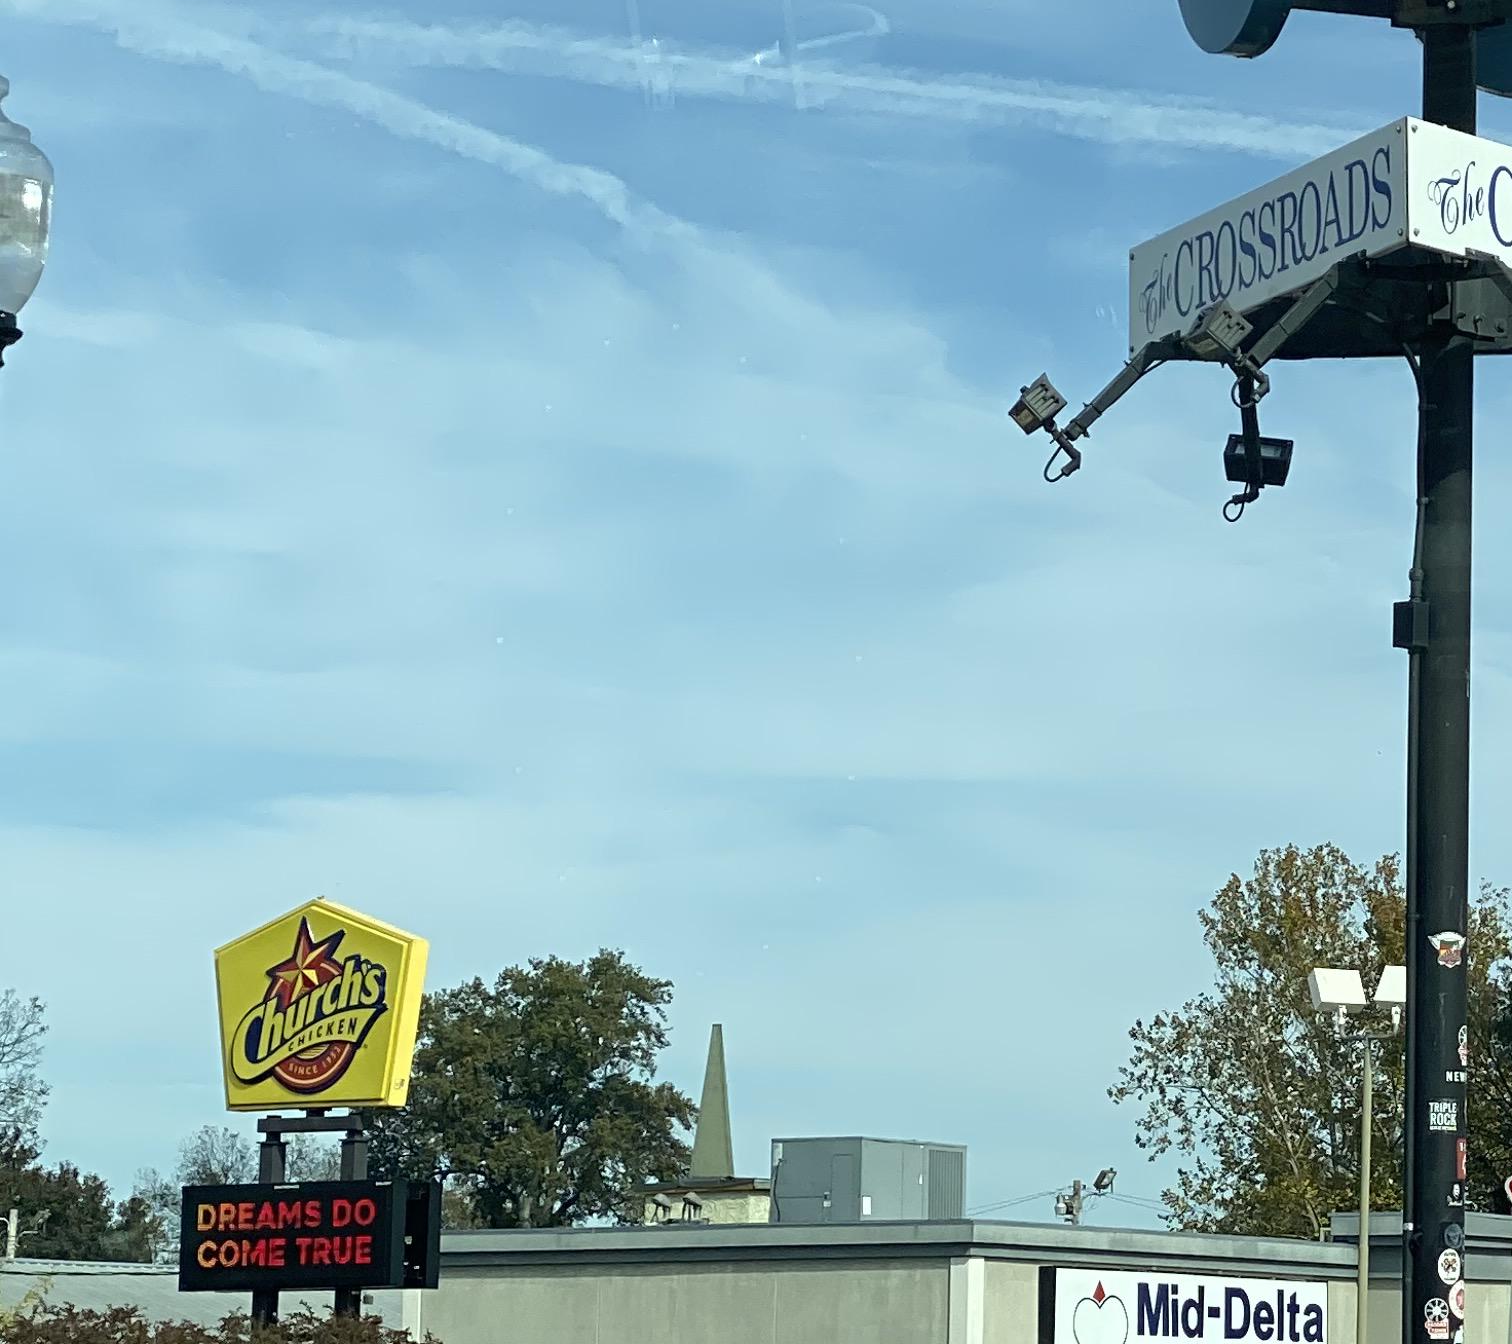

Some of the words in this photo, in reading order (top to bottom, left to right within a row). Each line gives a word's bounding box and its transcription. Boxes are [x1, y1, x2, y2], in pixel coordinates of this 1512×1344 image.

[1427, 160, 1485, 235] The
[1174, 144, 1392, 317] CROSSROADS
[232, 958, 383, 1080] Church's
[287, 1017, 358, 1052] CHICKEN
[287, 1061, 318, 1076] SINCE
[1428, 1102, 1457, 1114] TRIPLE
[1429, 1113, 1457, 1126] ROCK
[197, 1199, 322, 1231] DREAMS
[331, 1198, 376, 1228] DO
[197, 1238, 285, 1268] COME
[295, 1235, 372, 1266] TRUE
[1137, 1282, 1323, 1343] Mid-Delta
